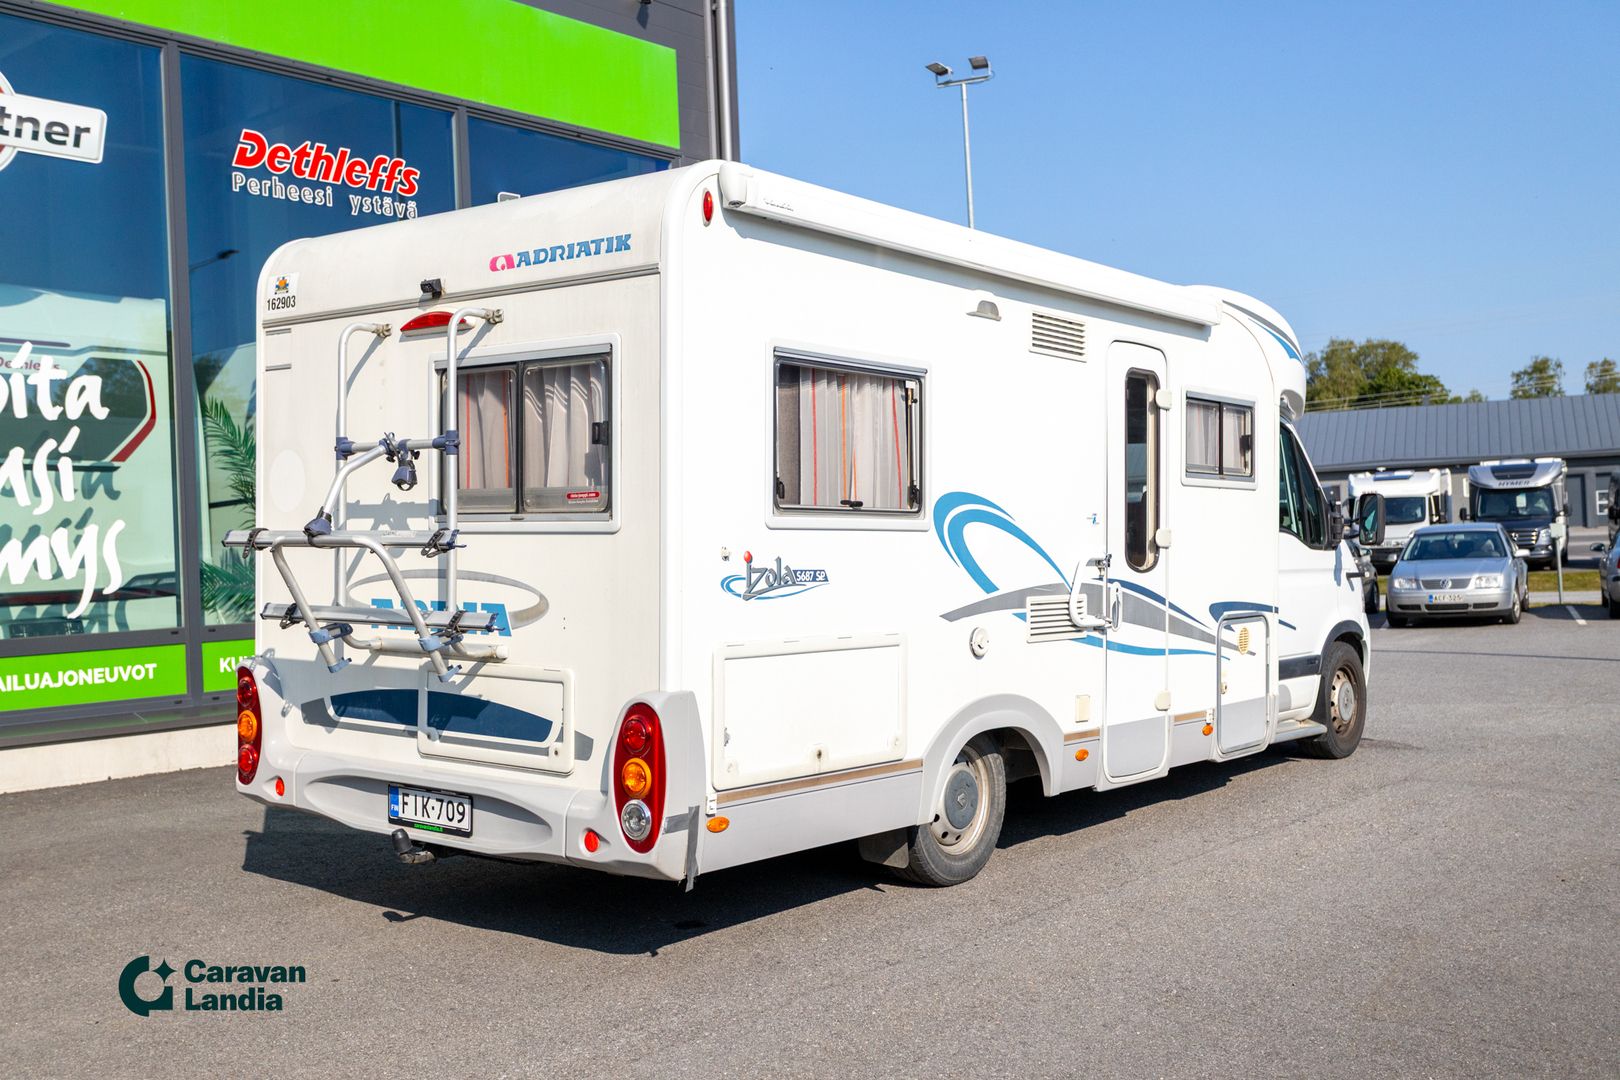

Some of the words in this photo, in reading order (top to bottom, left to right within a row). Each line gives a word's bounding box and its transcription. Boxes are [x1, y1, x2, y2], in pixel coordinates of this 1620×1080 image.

[232, 128, 420, 197] Dethleffs
[232, 172, 333, 207] Perheesi
[349, 194, 418, 219] ystävä
[516, 233, 632, 268] ADRIATIK
[267, 295, 296, 311] 162903
[402, 792, 466, 824] FIK-709
